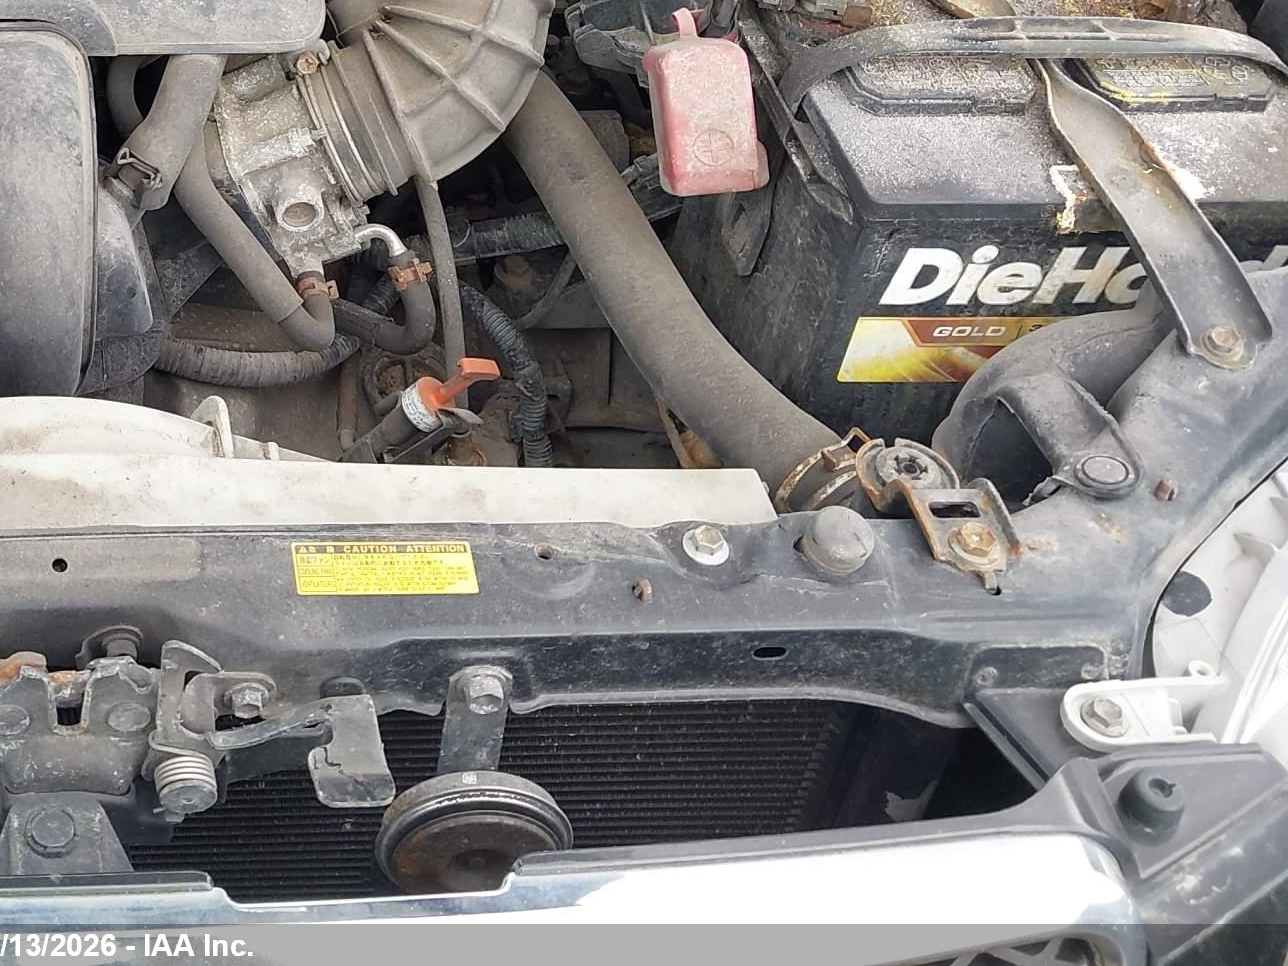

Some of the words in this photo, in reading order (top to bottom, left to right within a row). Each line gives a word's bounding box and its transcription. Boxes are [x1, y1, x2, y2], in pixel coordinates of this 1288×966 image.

[933, 326, 1007, 338] GOLD
[343, 544, 397, 554] CAUTION
[405, 543, 465, 553] ATTENTION
